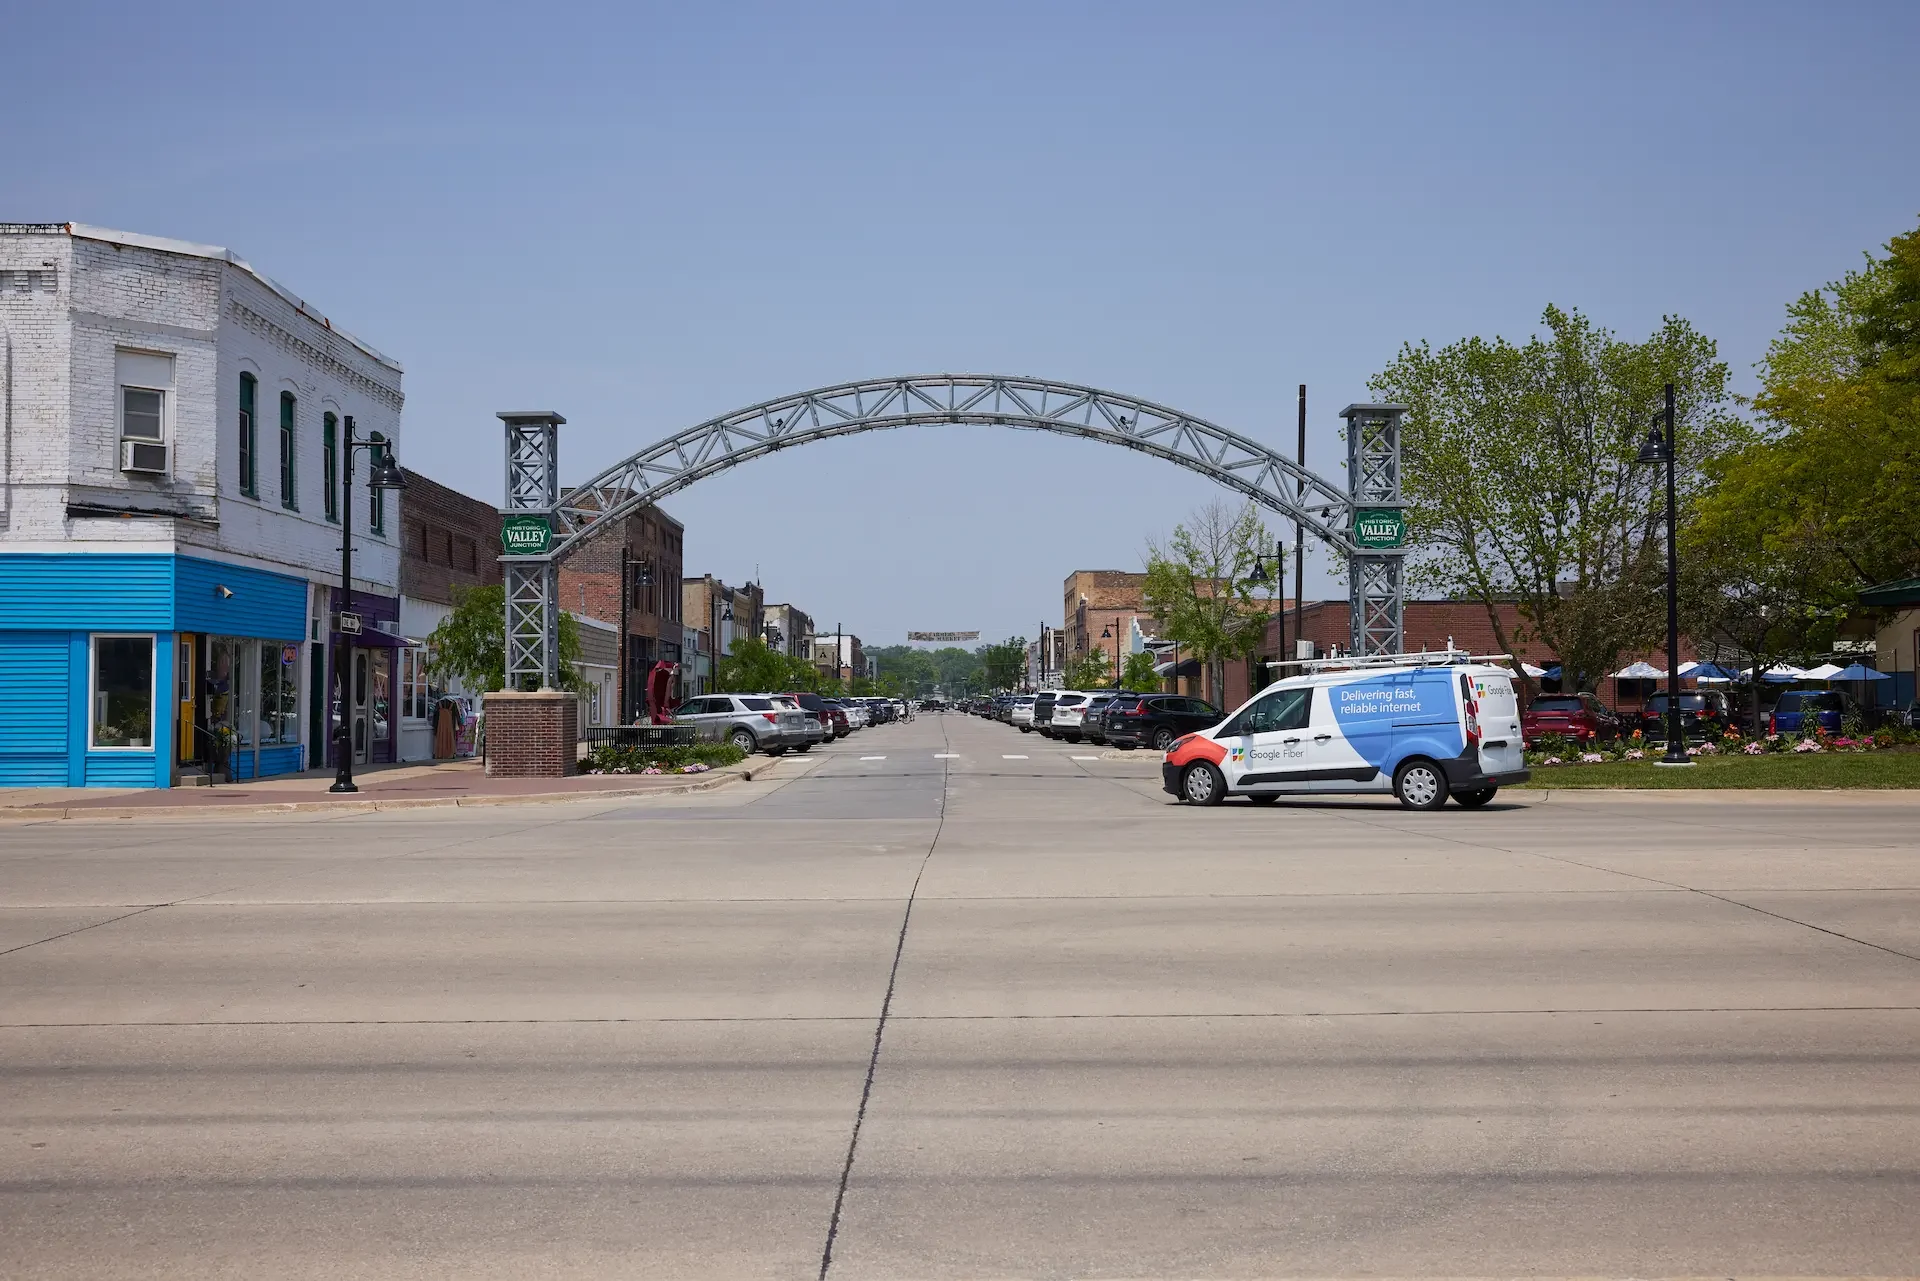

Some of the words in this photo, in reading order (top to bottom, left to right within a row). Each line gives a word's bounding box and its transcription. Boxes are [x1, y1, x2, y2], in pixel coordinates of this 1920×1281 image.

[506, 530, 547, 543] VALLEY
[1359, 523, 1401, 537] VALLEY
[284, 646, 296, 661] OPEN
[1341, 689, 1393, 702] Delivering
[1395, 688, 1417, 700] fast,
[1488, 684, 1504, 698] Google
[1340, 703, 1378, 714] reliable
[1380, 702, 1422, 713] internet
[1249, 749, 1281, 761] Google
[1283, 749, 1304, 758] Fiber
